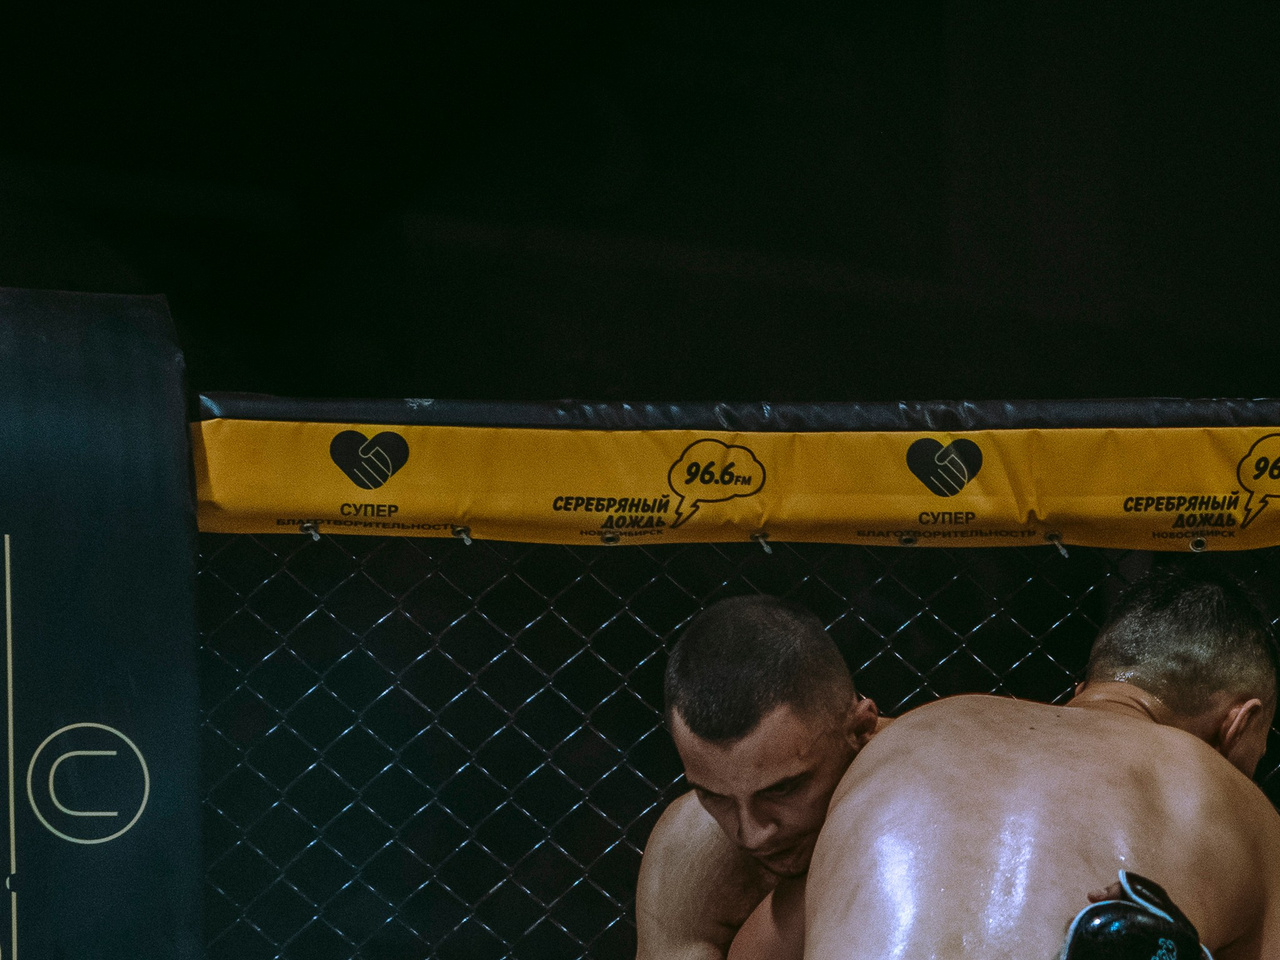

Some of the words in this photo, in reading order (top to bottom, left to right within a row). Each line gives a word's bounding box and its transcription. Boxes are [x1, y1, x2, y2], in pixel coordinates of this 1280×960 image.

[553, 495, 670, 513] СЕРЕБРЯНЫЙ
[1123, 490, 1240, 512] СЕРЕБРЯНЫЙ
[340, 503, 399, 517] СУПЕР
[601, 515, 666, 529] ДОЖДЬ
[918, 511, 976, 525] СУПЕР
[1172, 513, 1236, 528] ДОЖДЬ
